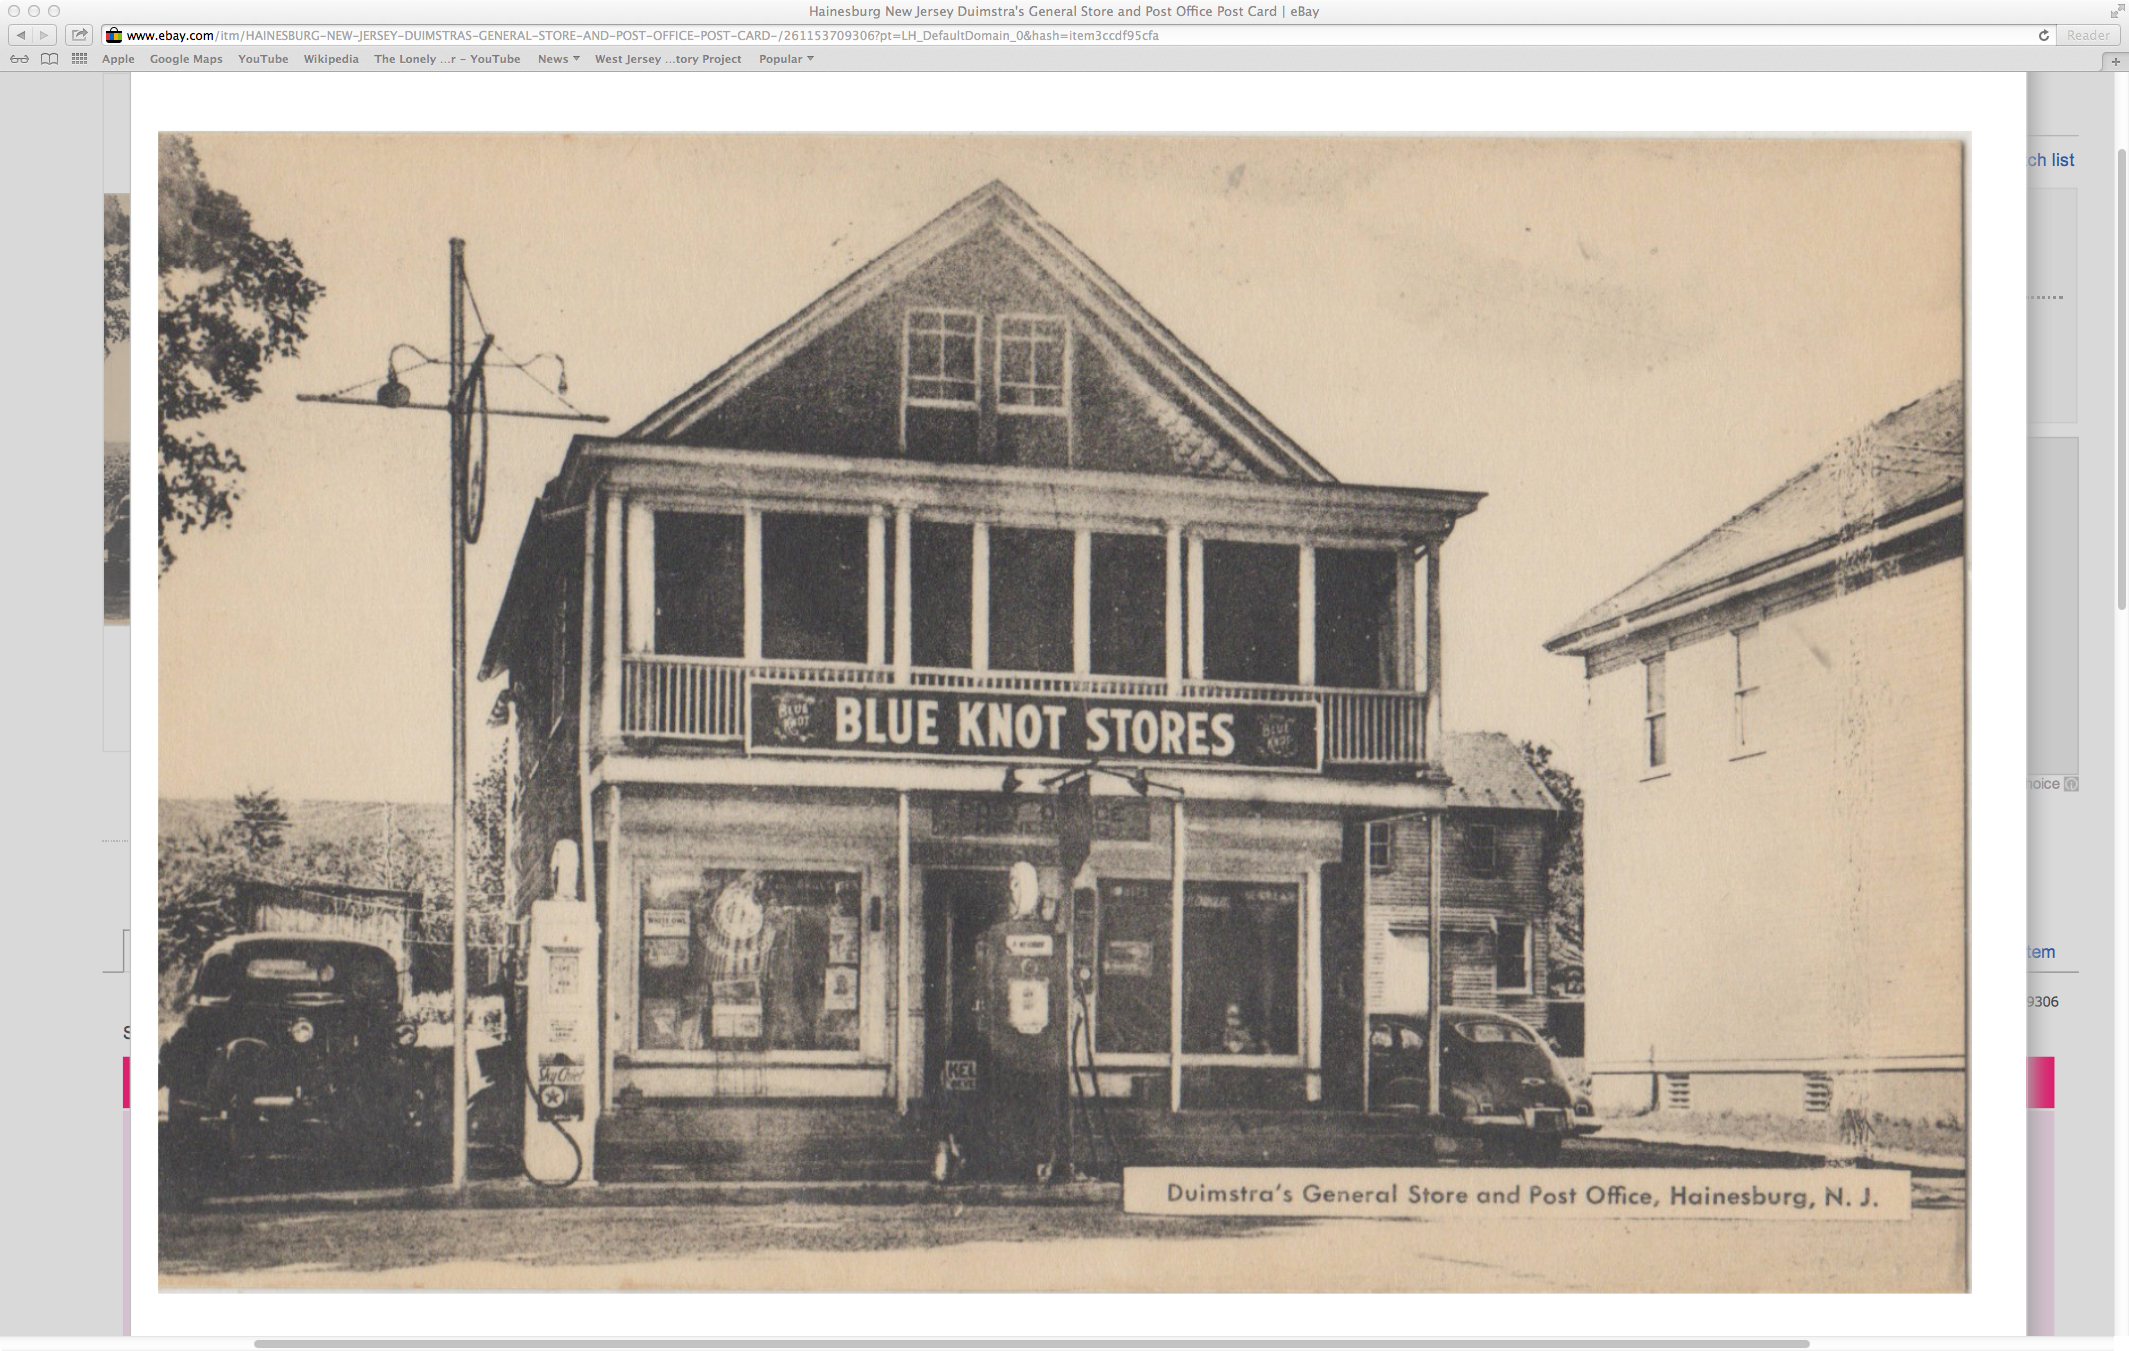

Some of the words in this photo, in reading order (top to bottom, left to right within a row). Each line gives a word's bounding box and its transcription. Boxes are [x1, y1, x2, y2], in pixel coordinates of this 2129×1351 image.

[809, 5, 881, 19] Hainesburg
[885, 5, 912, 17] New
[914, 5, 954, 19] Jersey
[957, 5, 1024, 17] Duimstra's
[1028, 5, 1076, 17] General
[1081, 5, 1114, 17] Store
[1117, 5, 1141, 17] and
[1145, 5, 1172, 17] Post
[1176, 5, 1213, 17] Office
[1217, 5, 1244, 17] Post
[1247, 5, 1277, 17] Card
[1290, 5, 1320, 19] eBay
[2067, 29, 2111, 41] Reader
[102, 54, 135, 66] Apple
[150, 54, 190, 66] Google
[194, 54, 223, 66] Maps
[238, 54, 289, 65] YouTube
[303, 54, 360, 66] Wikipedia
[374, 54, 396, 65] The
[399, 54, 437, 66] Lonely
[470, 54, 521, 65] YouTube
[538, 54, 569, 65] News
[595, 54, 624, 65] West
[625, 54, 662, 66] Jersey
[702, 54, 742, 66] Project
[759, 54, 803, 66] Popular
[2052, 152, 2076, 167] list
[836, 697, 939, 745] BLUE
[959, 701, 1067, 750] KNOT
[1085, 708, 1236, 757] STORES
